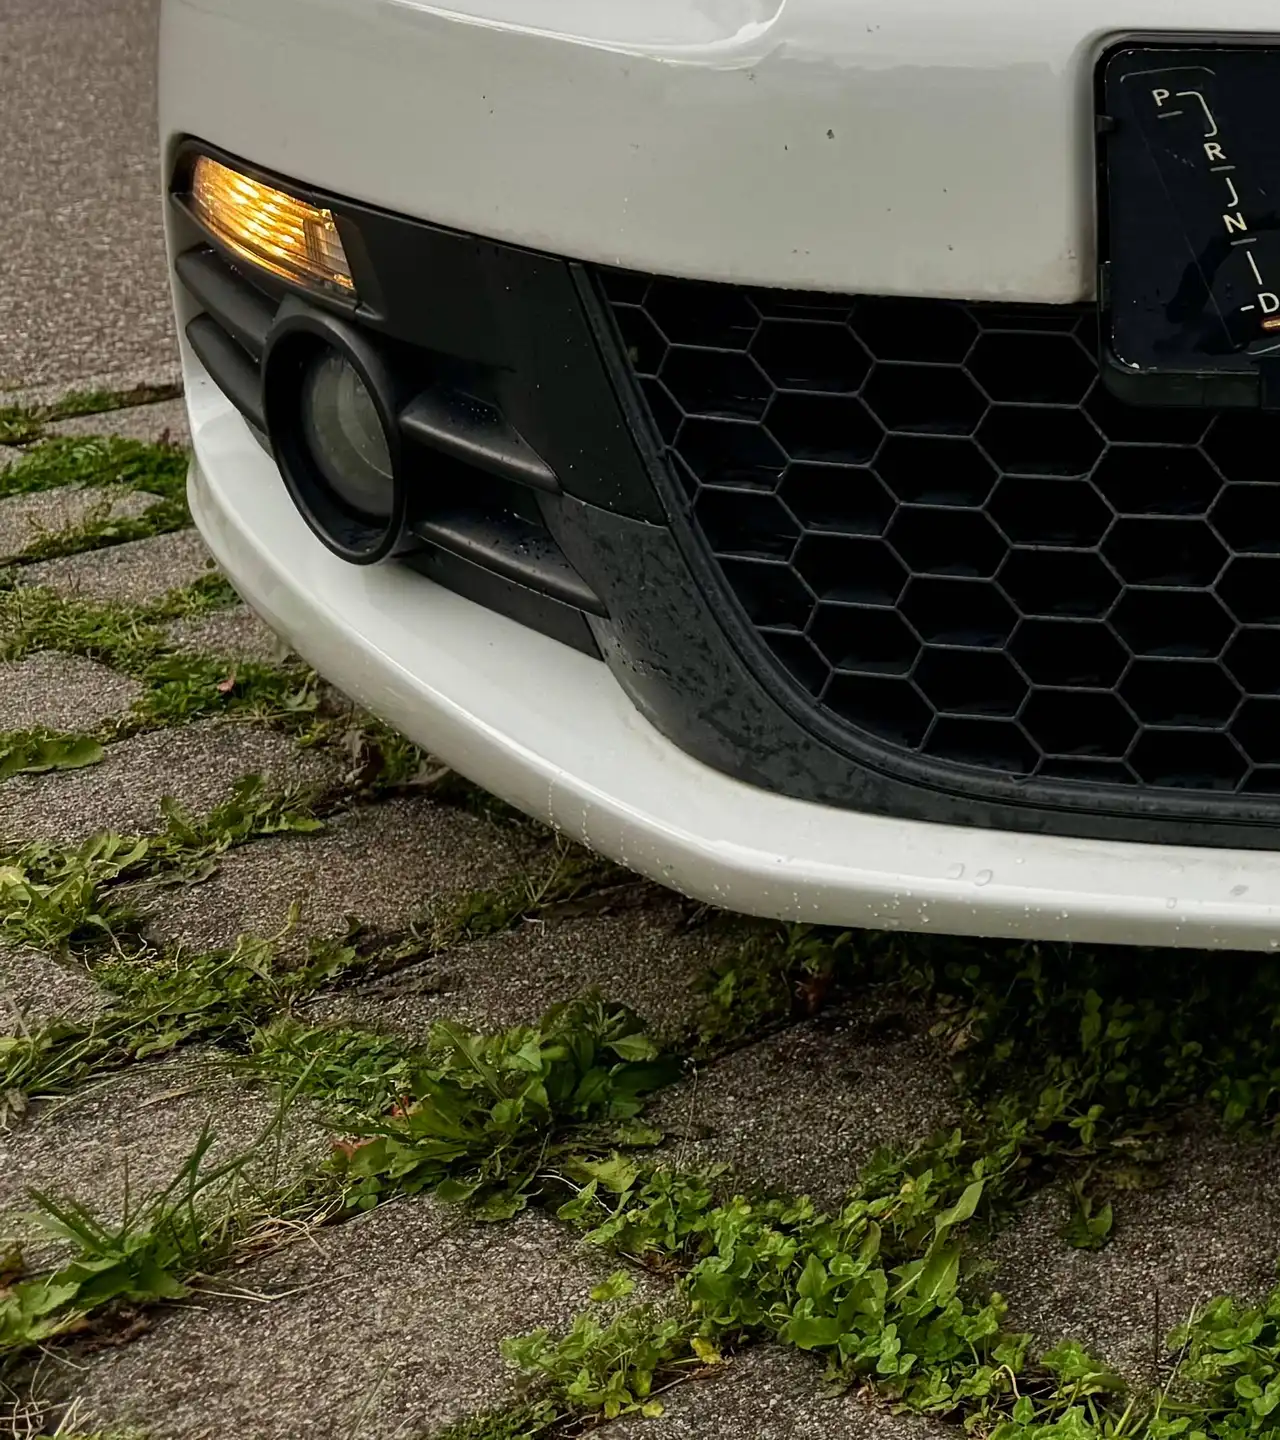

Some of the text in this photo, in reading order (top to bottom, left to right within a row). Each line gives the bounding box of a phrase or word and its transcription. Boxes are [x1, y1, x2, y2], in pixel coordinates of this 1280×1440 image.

[1151, 88, 1170, 107] P
[1203, 142, 1227, 161] R
[1222, 212, 1248, 233] N
